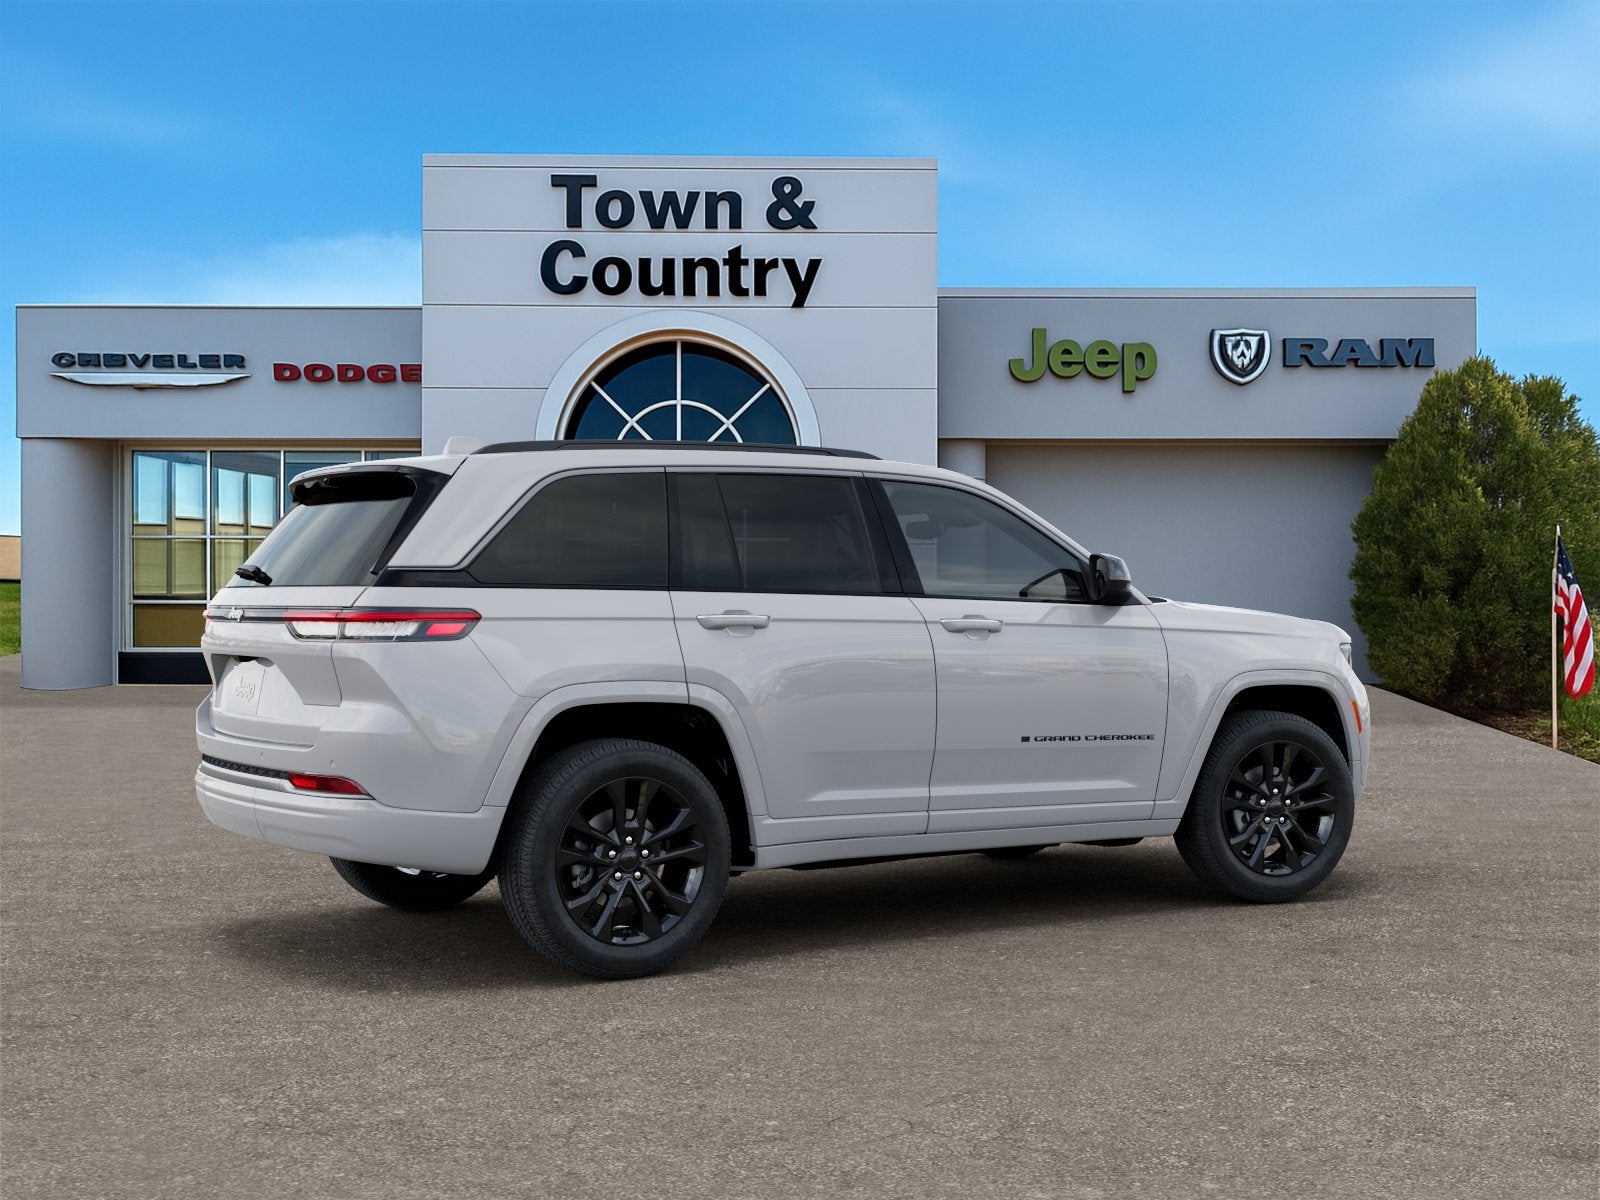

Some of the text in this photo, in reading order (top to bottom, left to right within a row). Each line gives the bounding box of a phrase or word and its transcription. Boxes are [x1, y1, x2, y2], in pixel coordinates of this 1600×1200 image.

[550, 174, 818, 230] Town &
[539, 239, 823, 308] Country
[272, 363, 422, 383] DODGE
[1008, 328, 1158, 393] Jeep
[1282, 337, 1436, 368] RAM
